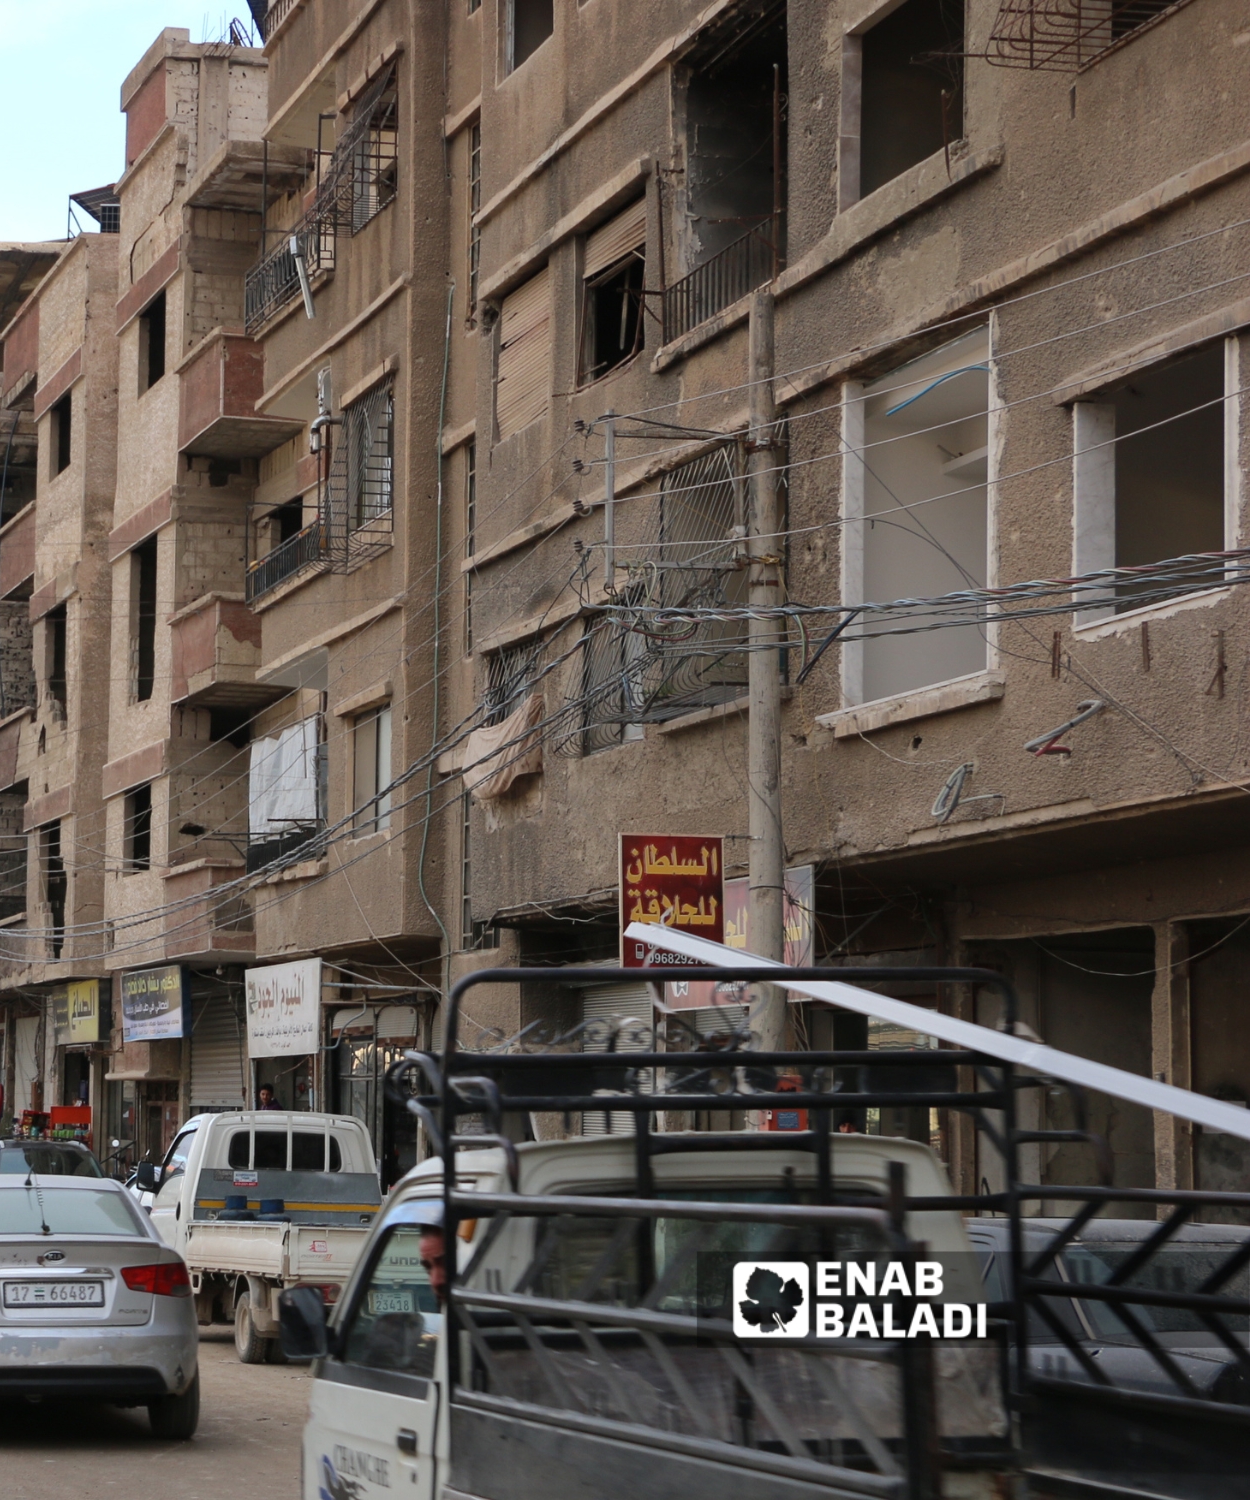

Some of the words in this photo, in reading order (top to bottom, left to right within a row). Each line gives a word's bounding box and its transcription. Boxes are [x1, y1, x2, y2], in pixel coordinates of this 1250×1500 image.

[626, 844, 718, 883] السلطان
[629, 888, 718, 926] للحلاقة
[12, 1286, 29, 1302] 17
[50, 1286, 95, 1301] 66487
[376, 1300, 410, 1311] 23418
